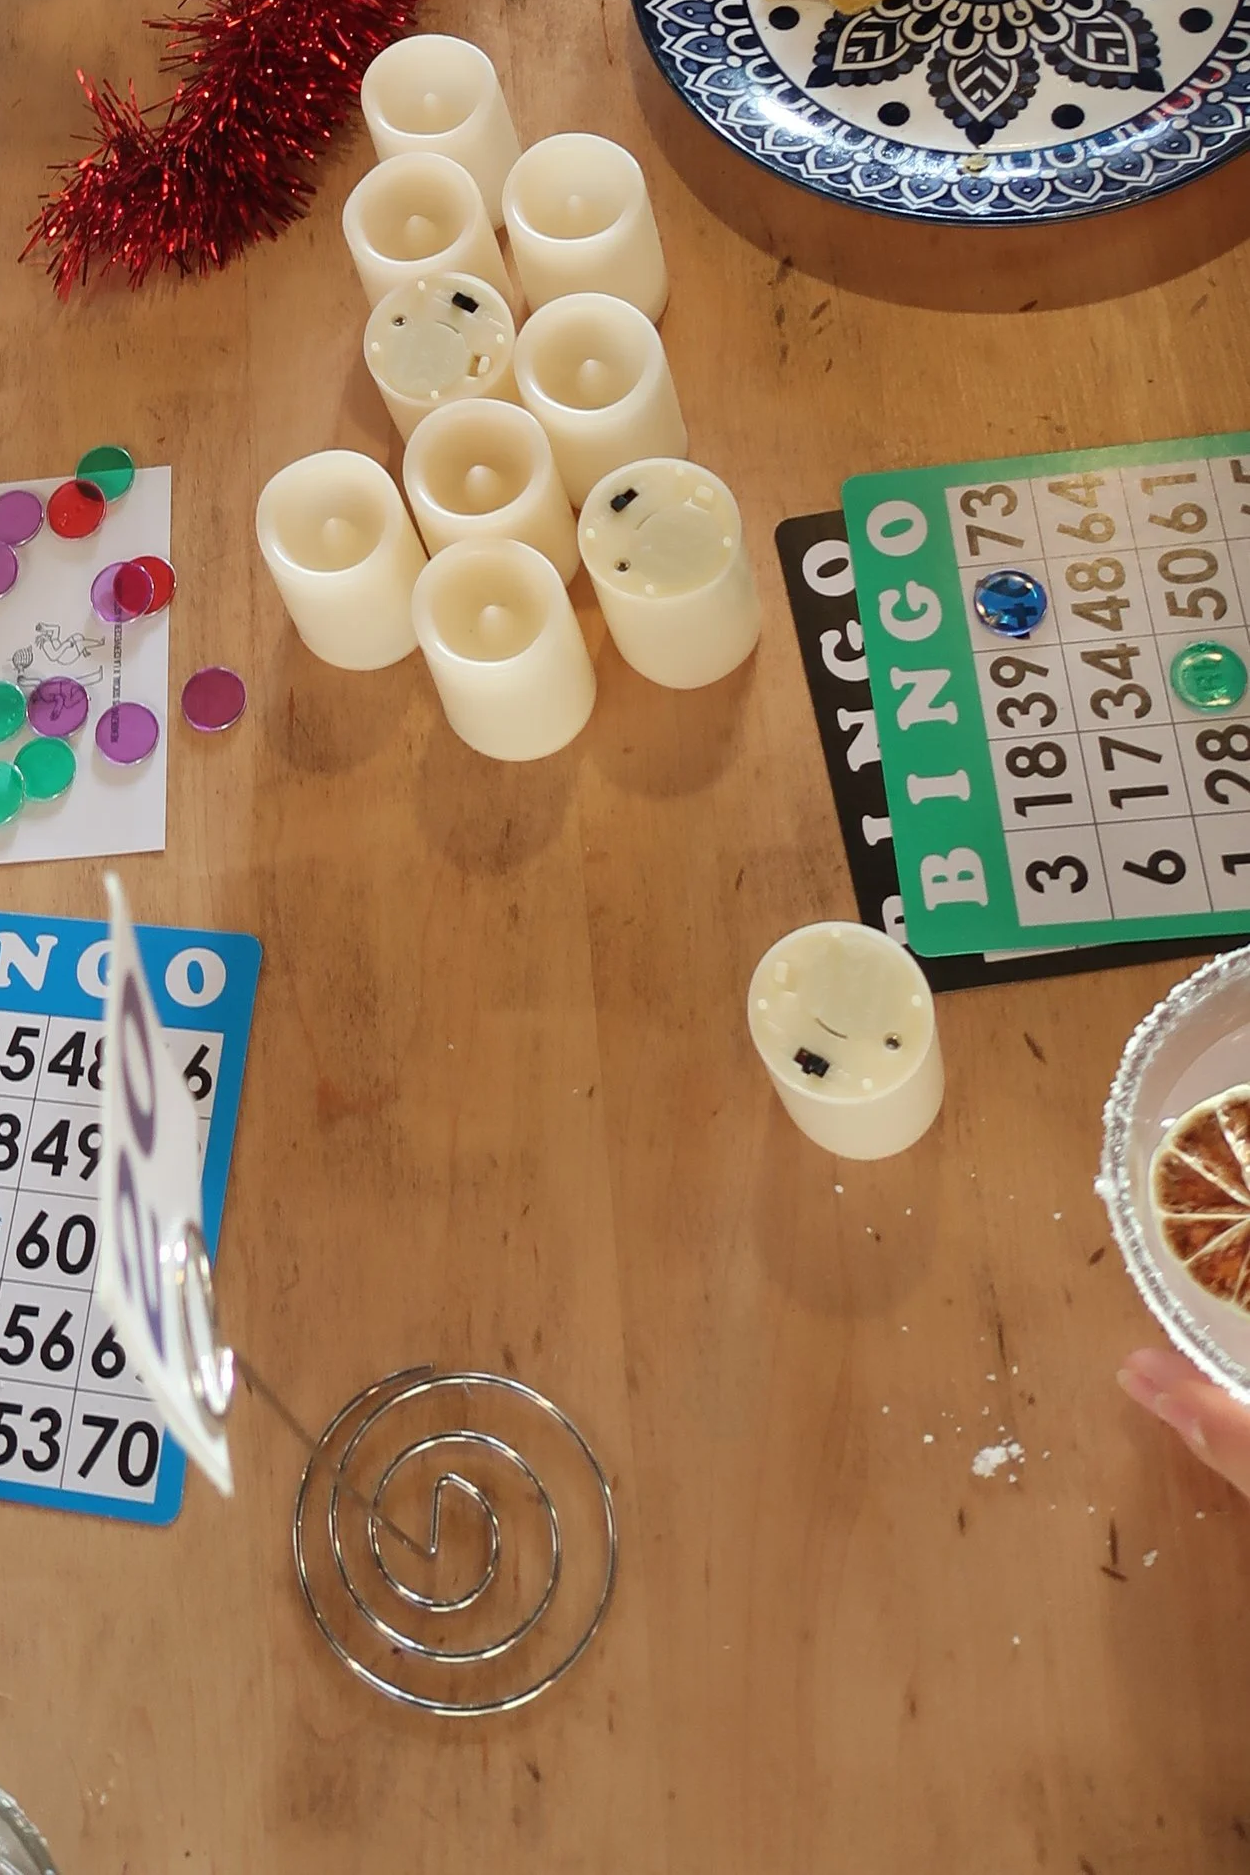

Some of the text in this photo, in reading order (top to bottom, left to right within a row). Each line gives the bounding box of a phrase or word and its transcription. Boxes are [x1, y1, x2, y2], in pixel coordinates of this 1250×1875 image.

[866, 499, 989, 911] BINGO
[959, 484, 1089, 894] 3 18 39 73
[1047, 473, 1187, 885] 6 17 34 48 64
[15, 1210, 96, 1275] 60
[77, 1414, 160, 1487] 70
